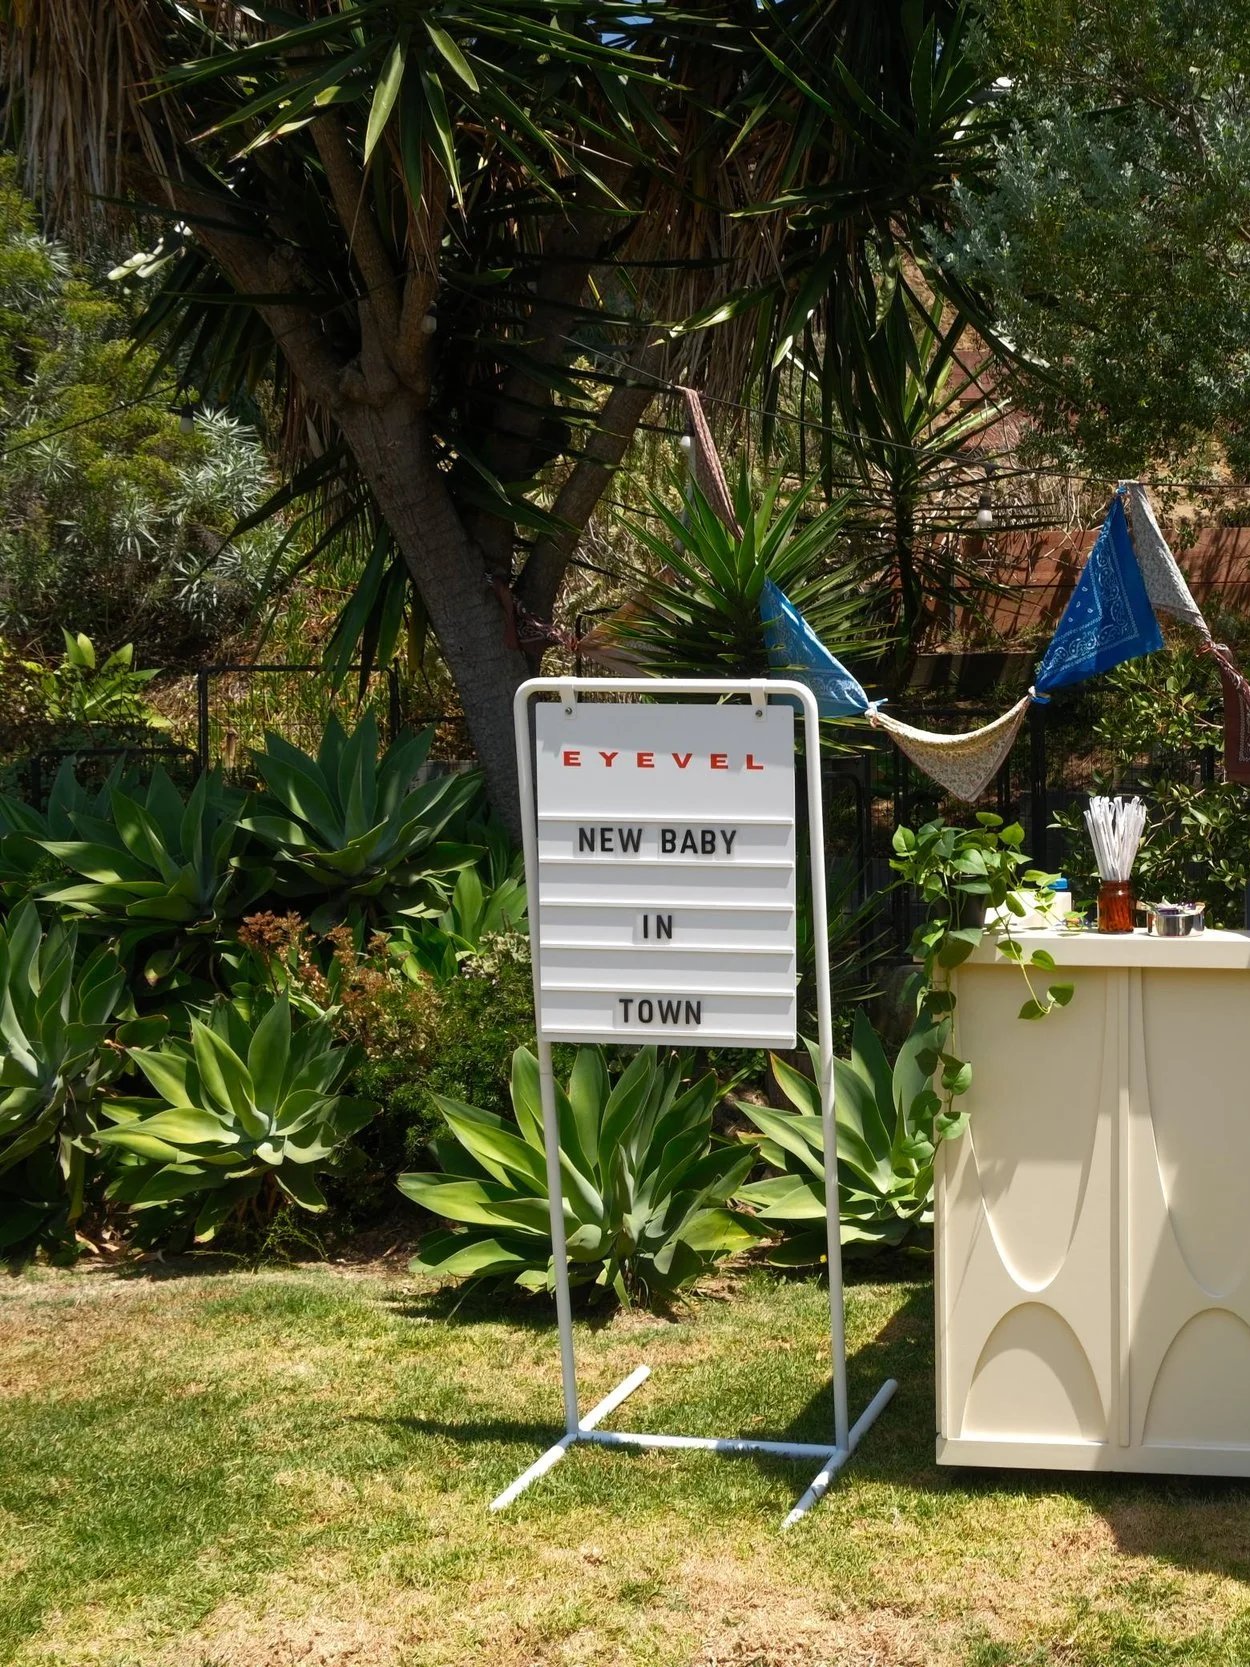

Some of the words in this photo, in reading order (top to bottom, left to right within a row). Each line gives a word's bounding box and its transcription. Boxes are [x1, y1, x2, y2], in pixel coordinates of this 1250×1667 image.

[563, 751, 764, 770] EYEVEL
[578, 827, 643, 852] NEW
[661, 829, 737, 855] BABY
[642, 914, 673, 940] IN
[618, 998, 702, 1025] TOWN
